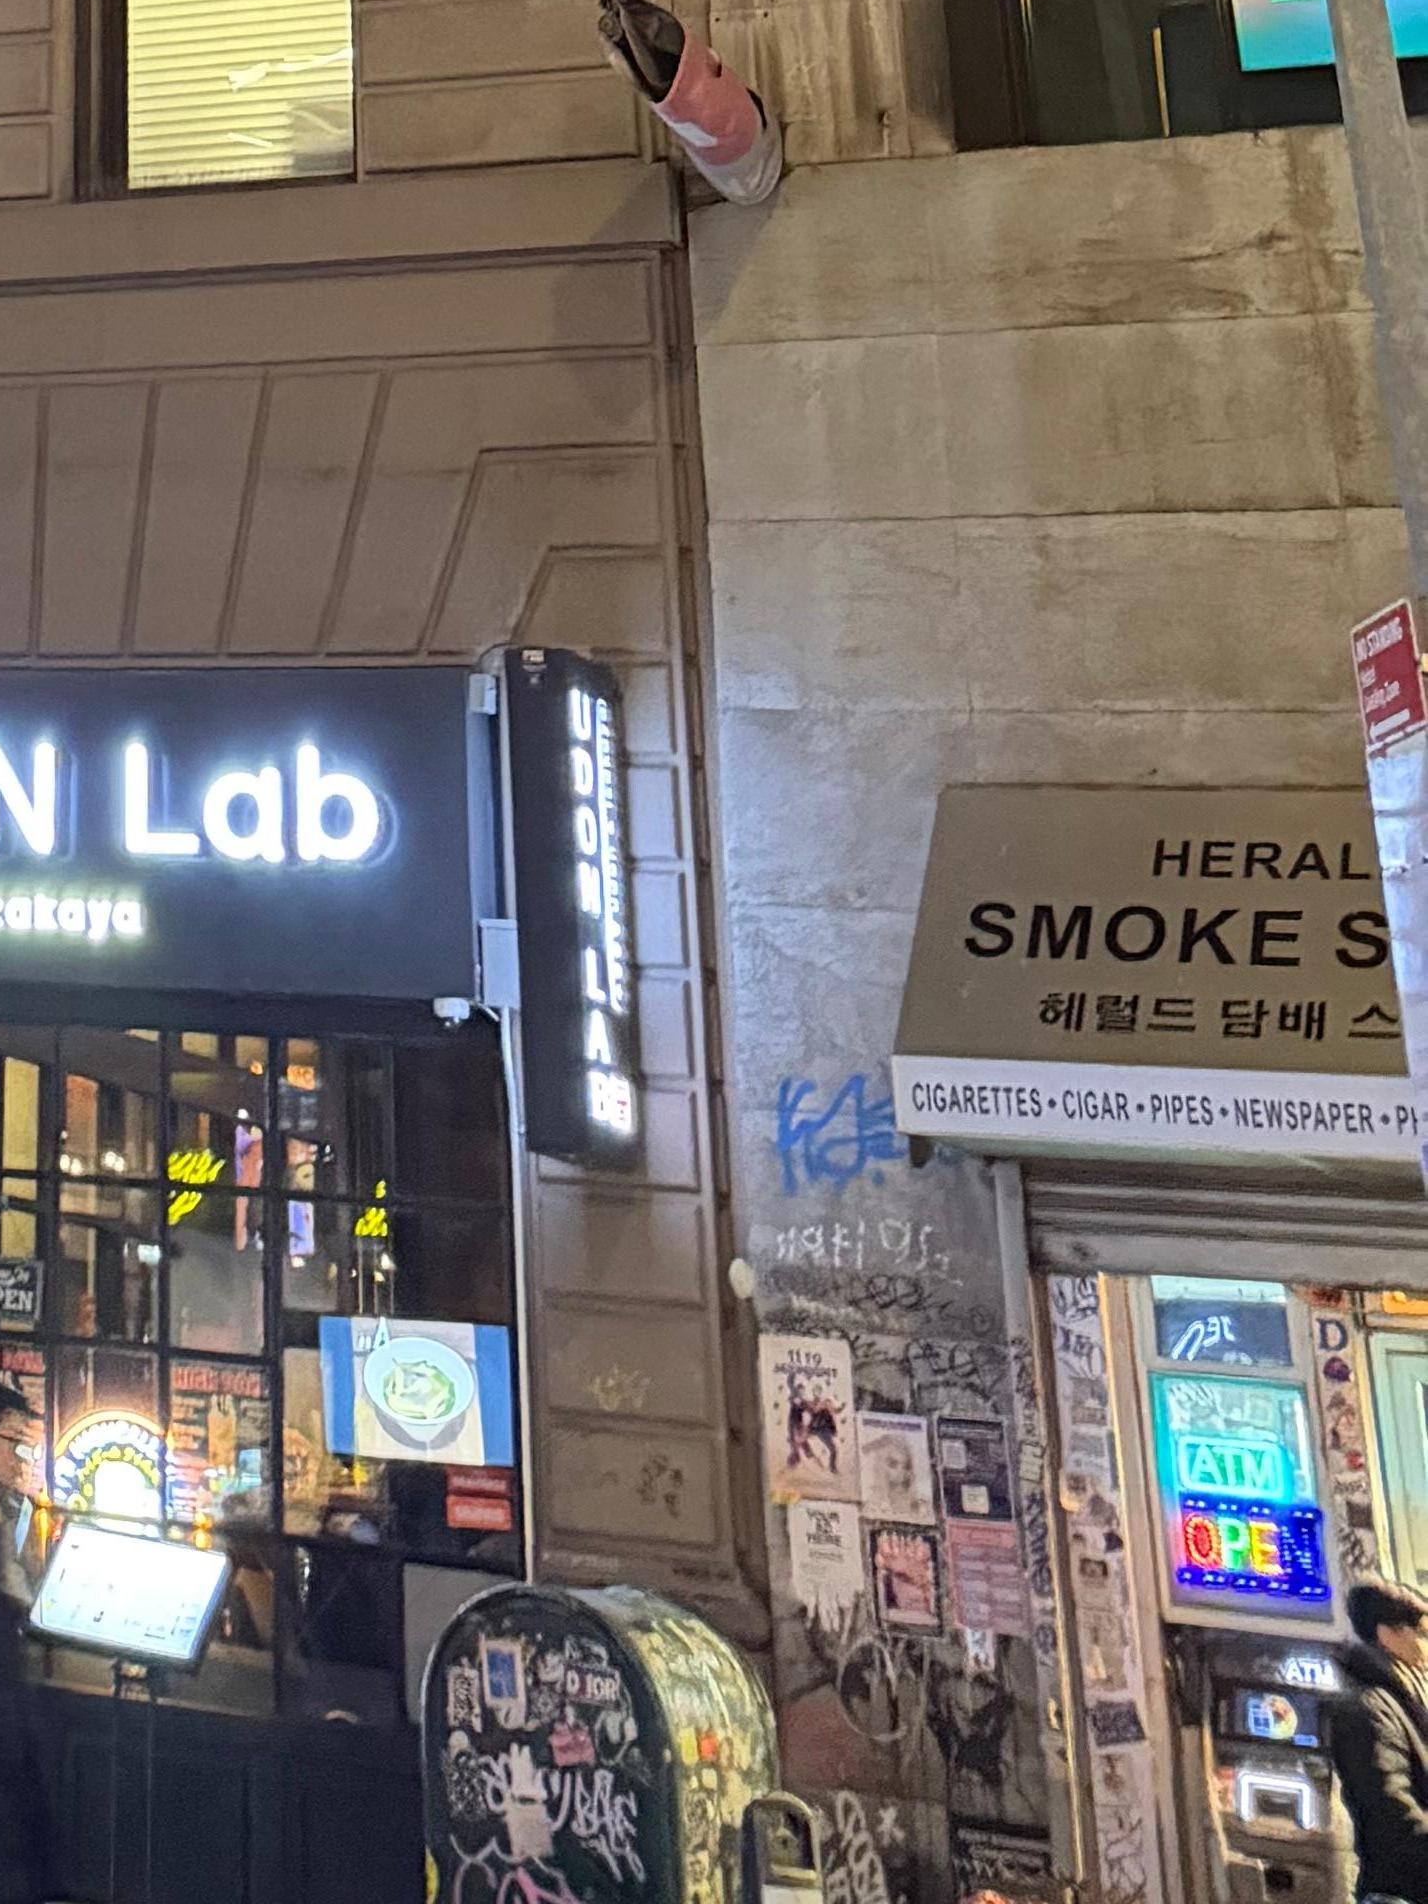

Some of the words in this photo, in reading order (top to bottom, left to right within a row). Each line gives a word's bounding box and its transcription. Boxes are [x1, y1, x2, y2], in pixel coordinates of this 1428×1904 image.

[124, 741, 382, 864] Lab
[570, 688, 601, 920] UDON
[1152, 839, 1382, 881] HERAL
[963, 901, 1304, 968] SMOKE
[1038, 992, 1196, 1034] 헤럴드
[1220, 998, 1328, 1041] 담배
[911, 1082, 1042, 1119] CIGARETTES
[1062, 1089, 1129, 1122] CIGAR
[1150, 1093, 1214, 1127] PIPES
[1234, 1097, 1375, 1134] NEWSPAPER
[1189, 1443, 1275, 1490] ATM
[1183, 1514, 1316, 1577] OPEN
[1284, 1657, 1335, 1686] ATM
